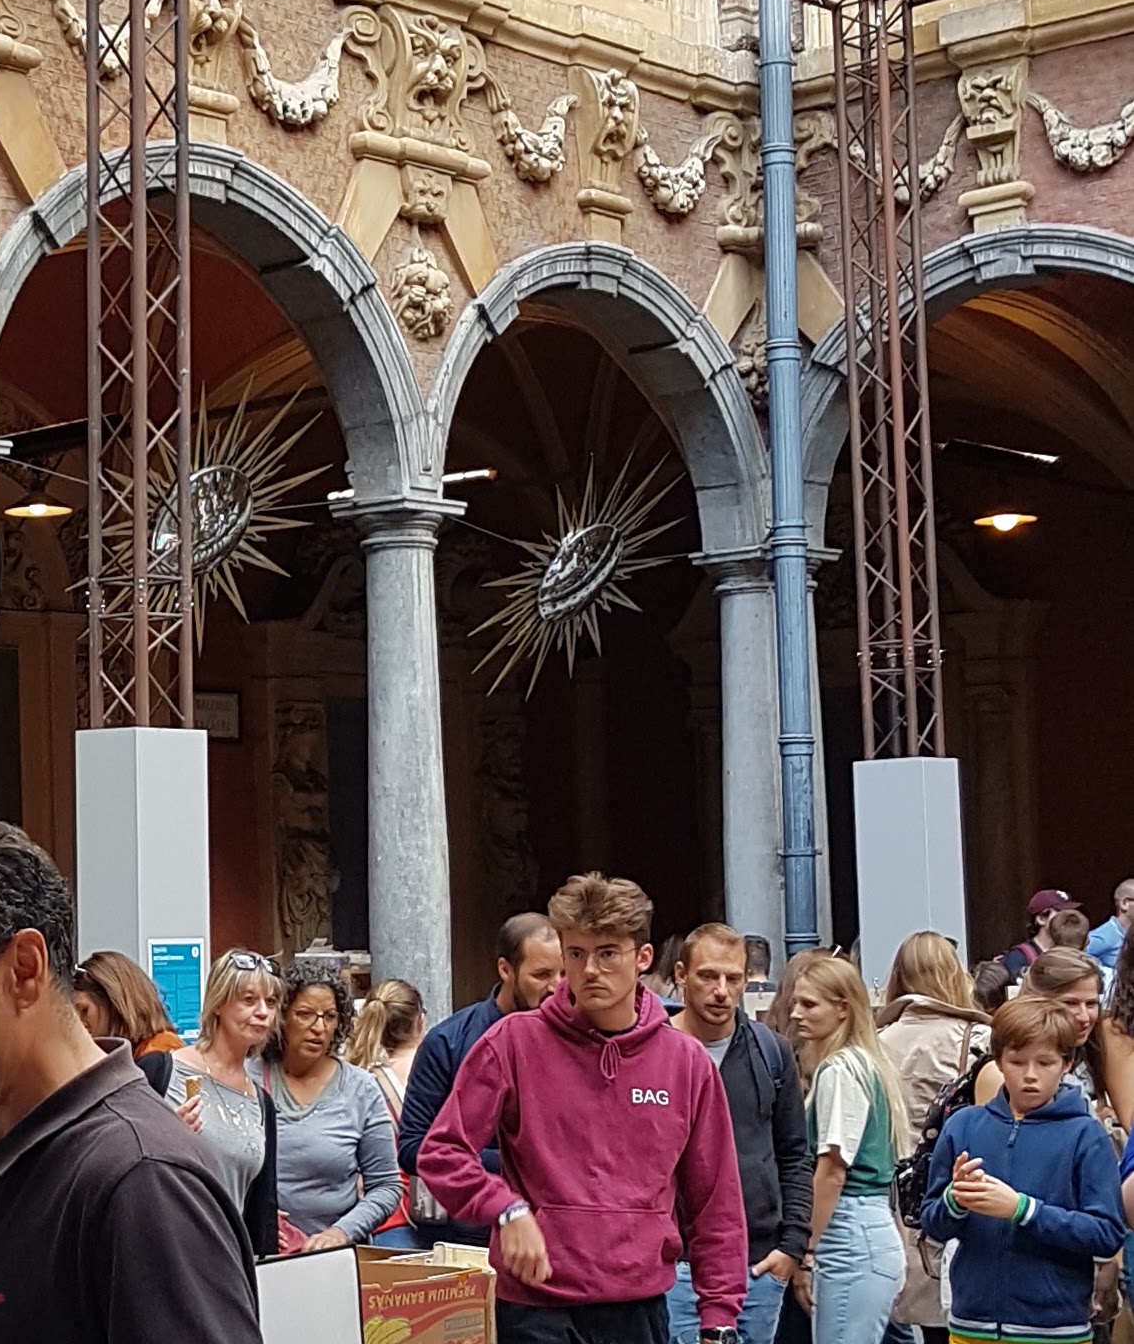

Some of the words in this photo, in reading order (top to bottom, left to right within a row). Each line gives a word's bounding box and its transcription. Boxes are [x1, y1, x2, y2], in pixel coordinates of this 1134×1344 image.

[631, 1088, 670, 1106] BAG
[368, 1288, 425, 1309] BANANAS
[428, 1283, 477, 1304] PREMIUM
